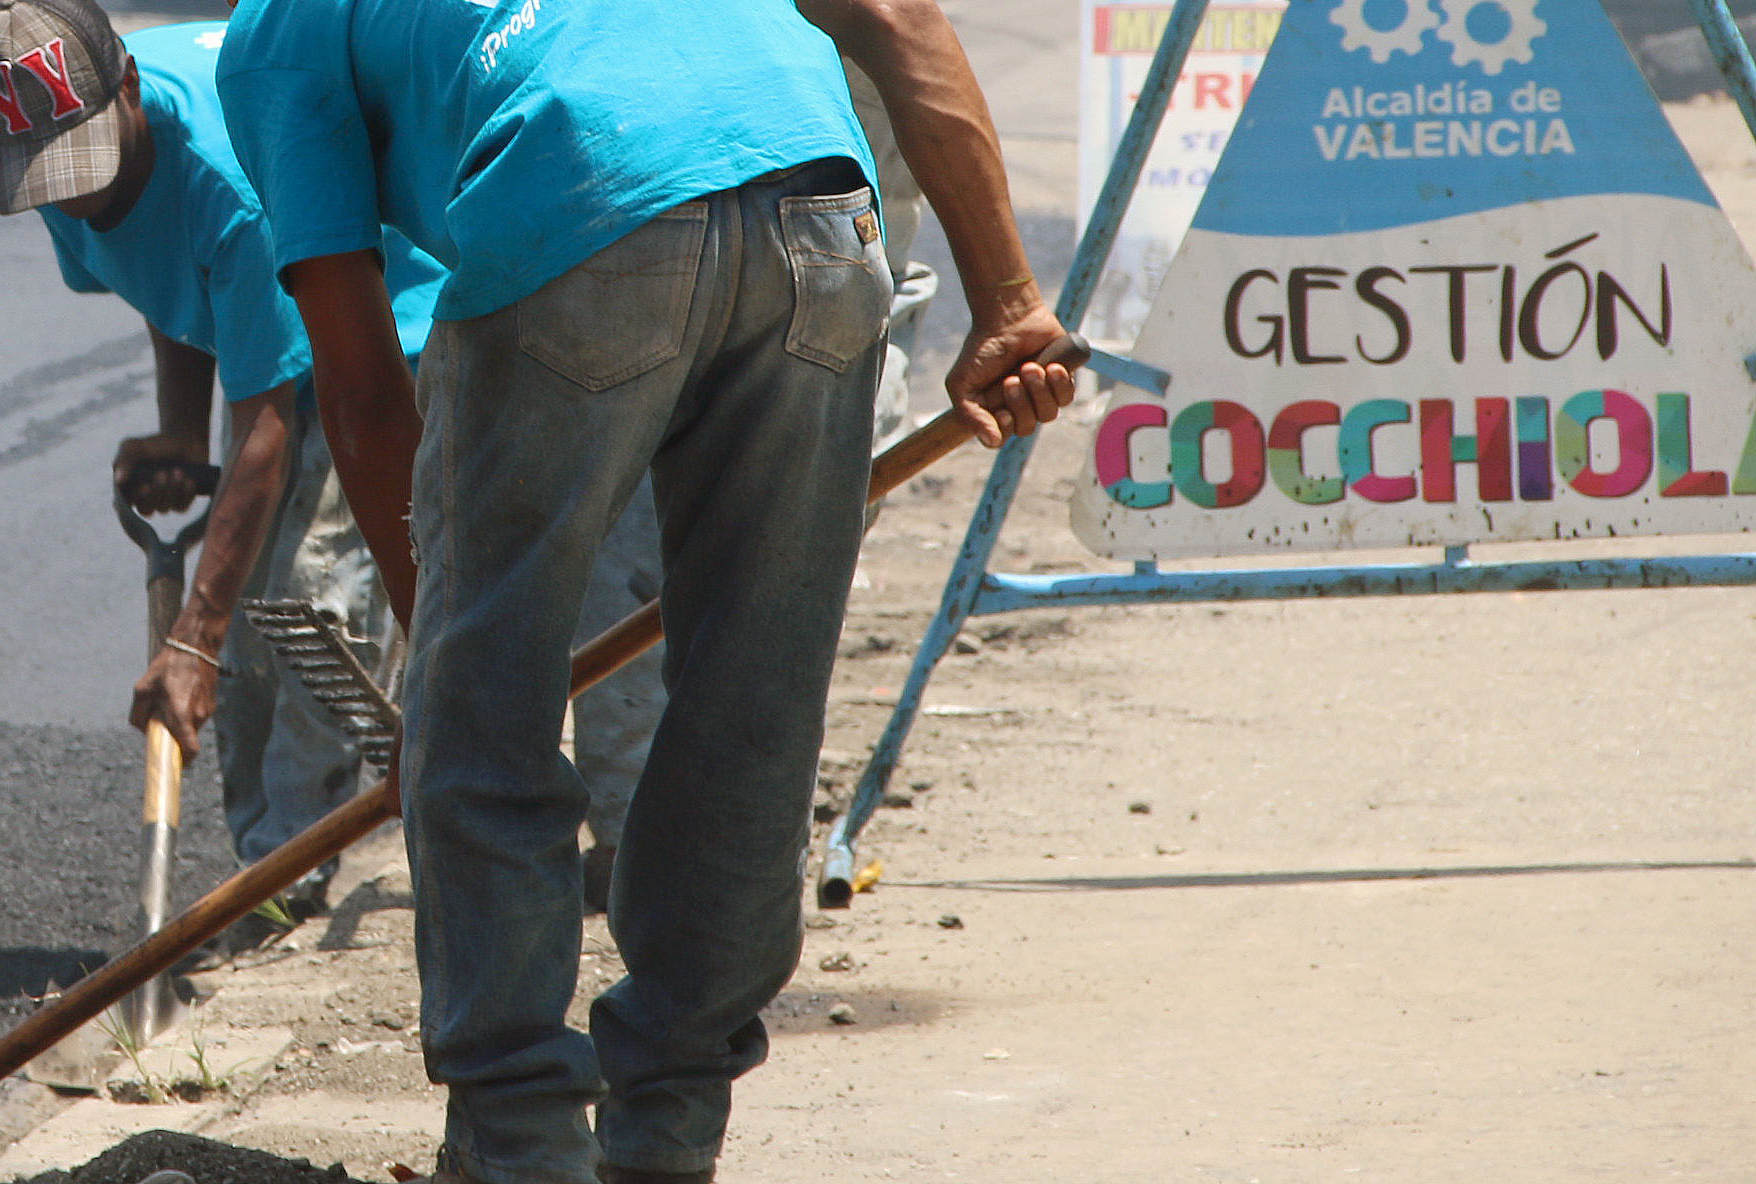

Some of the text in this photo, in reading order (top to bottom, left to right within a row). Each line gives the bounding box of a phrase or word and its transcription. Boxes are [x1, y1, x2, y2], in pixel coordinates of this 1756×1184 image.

[1313, 118, 1575, 161] VALENCIA
[1322, 81, 1562, 118] Alcaldía de
[1223, 232, 1673, 368] GESTIÓN
[1094, 389, 1755, 510] COCCHIOL
